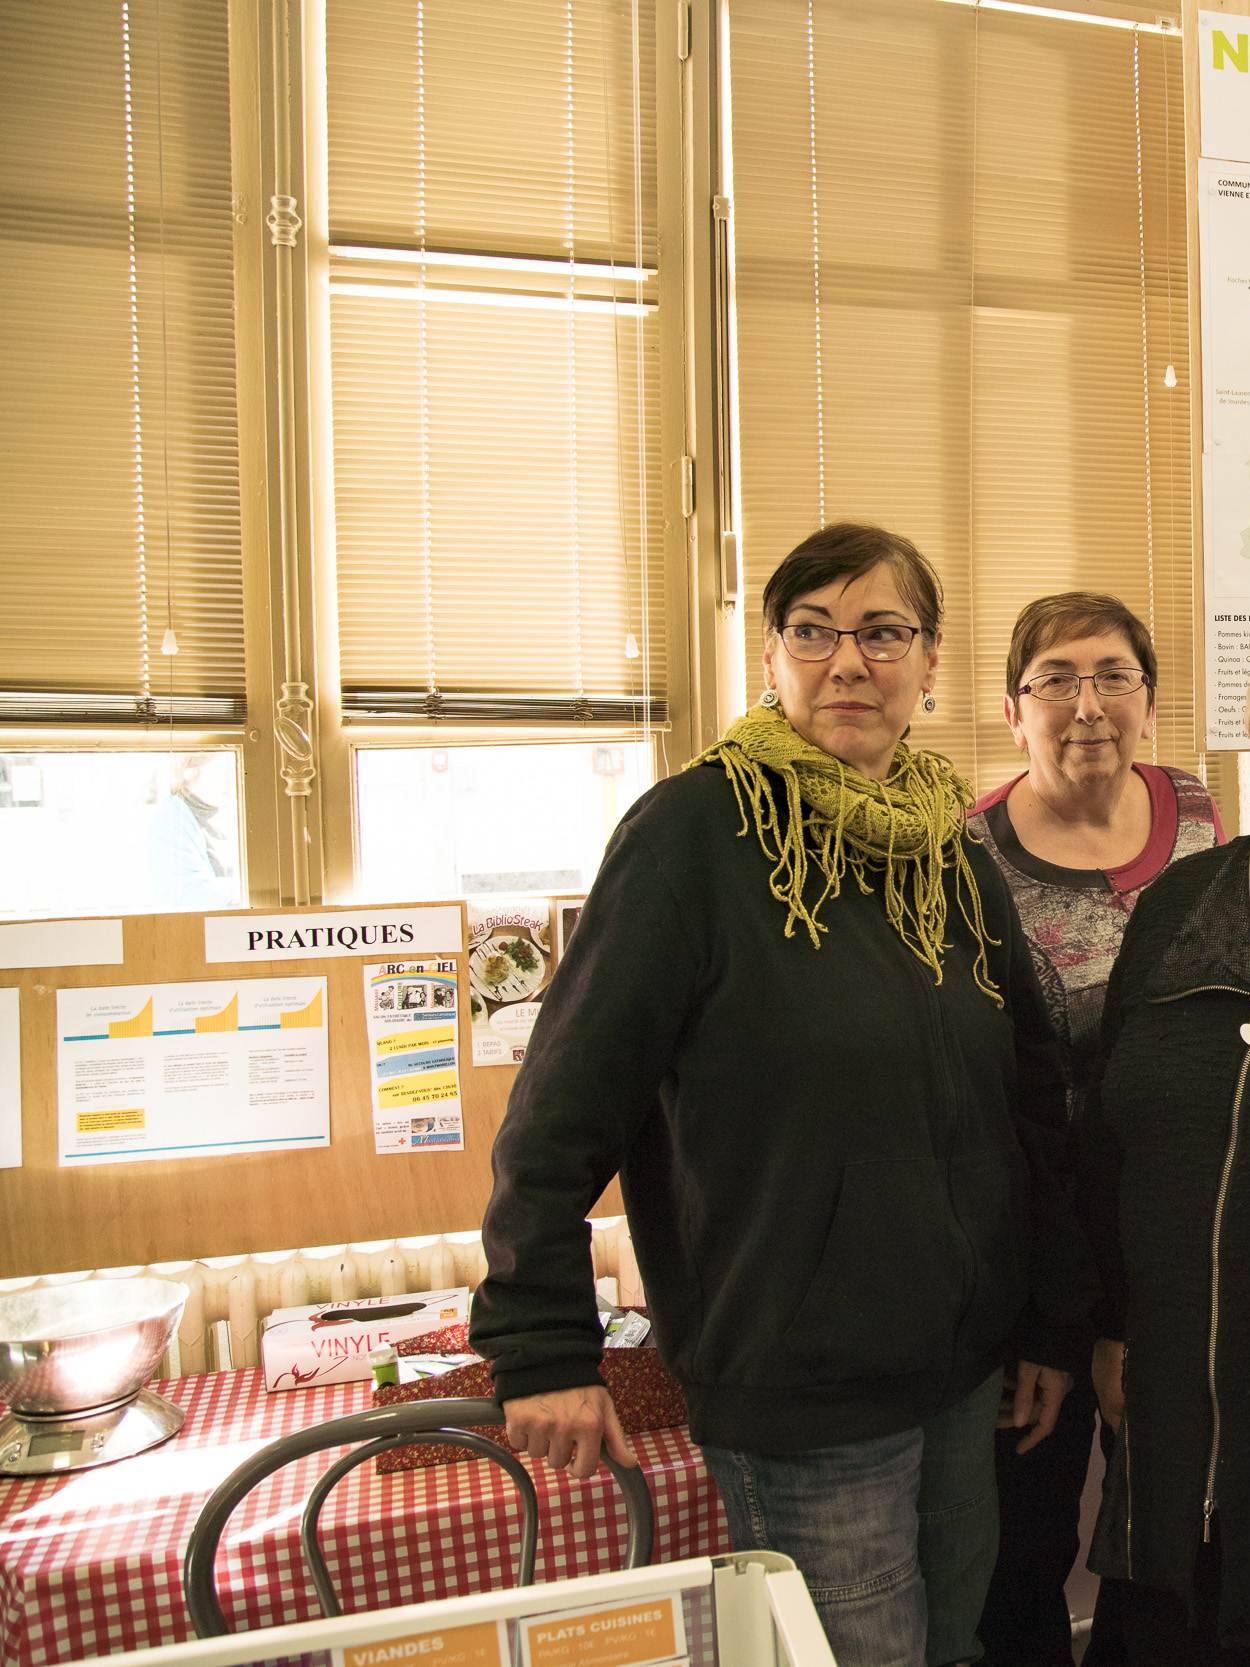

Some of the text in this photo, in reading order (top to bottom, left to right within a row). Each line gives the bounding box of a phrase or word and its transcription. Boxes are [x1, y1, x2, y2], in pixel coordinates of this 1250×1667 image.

[1218, 190, 1244, 198] VIENNE
[472, 924, 485, 935] La
[247, 923, 414, 951] PRATIQUES
[378, 962, 457, 975] ARC en CIEL
[516, 1009, 525, 1017] LE
[316, 1297, 390, 1309] VINYLE
[311, 1332, 390, 1358] VINYLE
[536, 1610, 663, 1644] PLATS CUISINES
[353, 1636, 444, 1667] VIANDES
